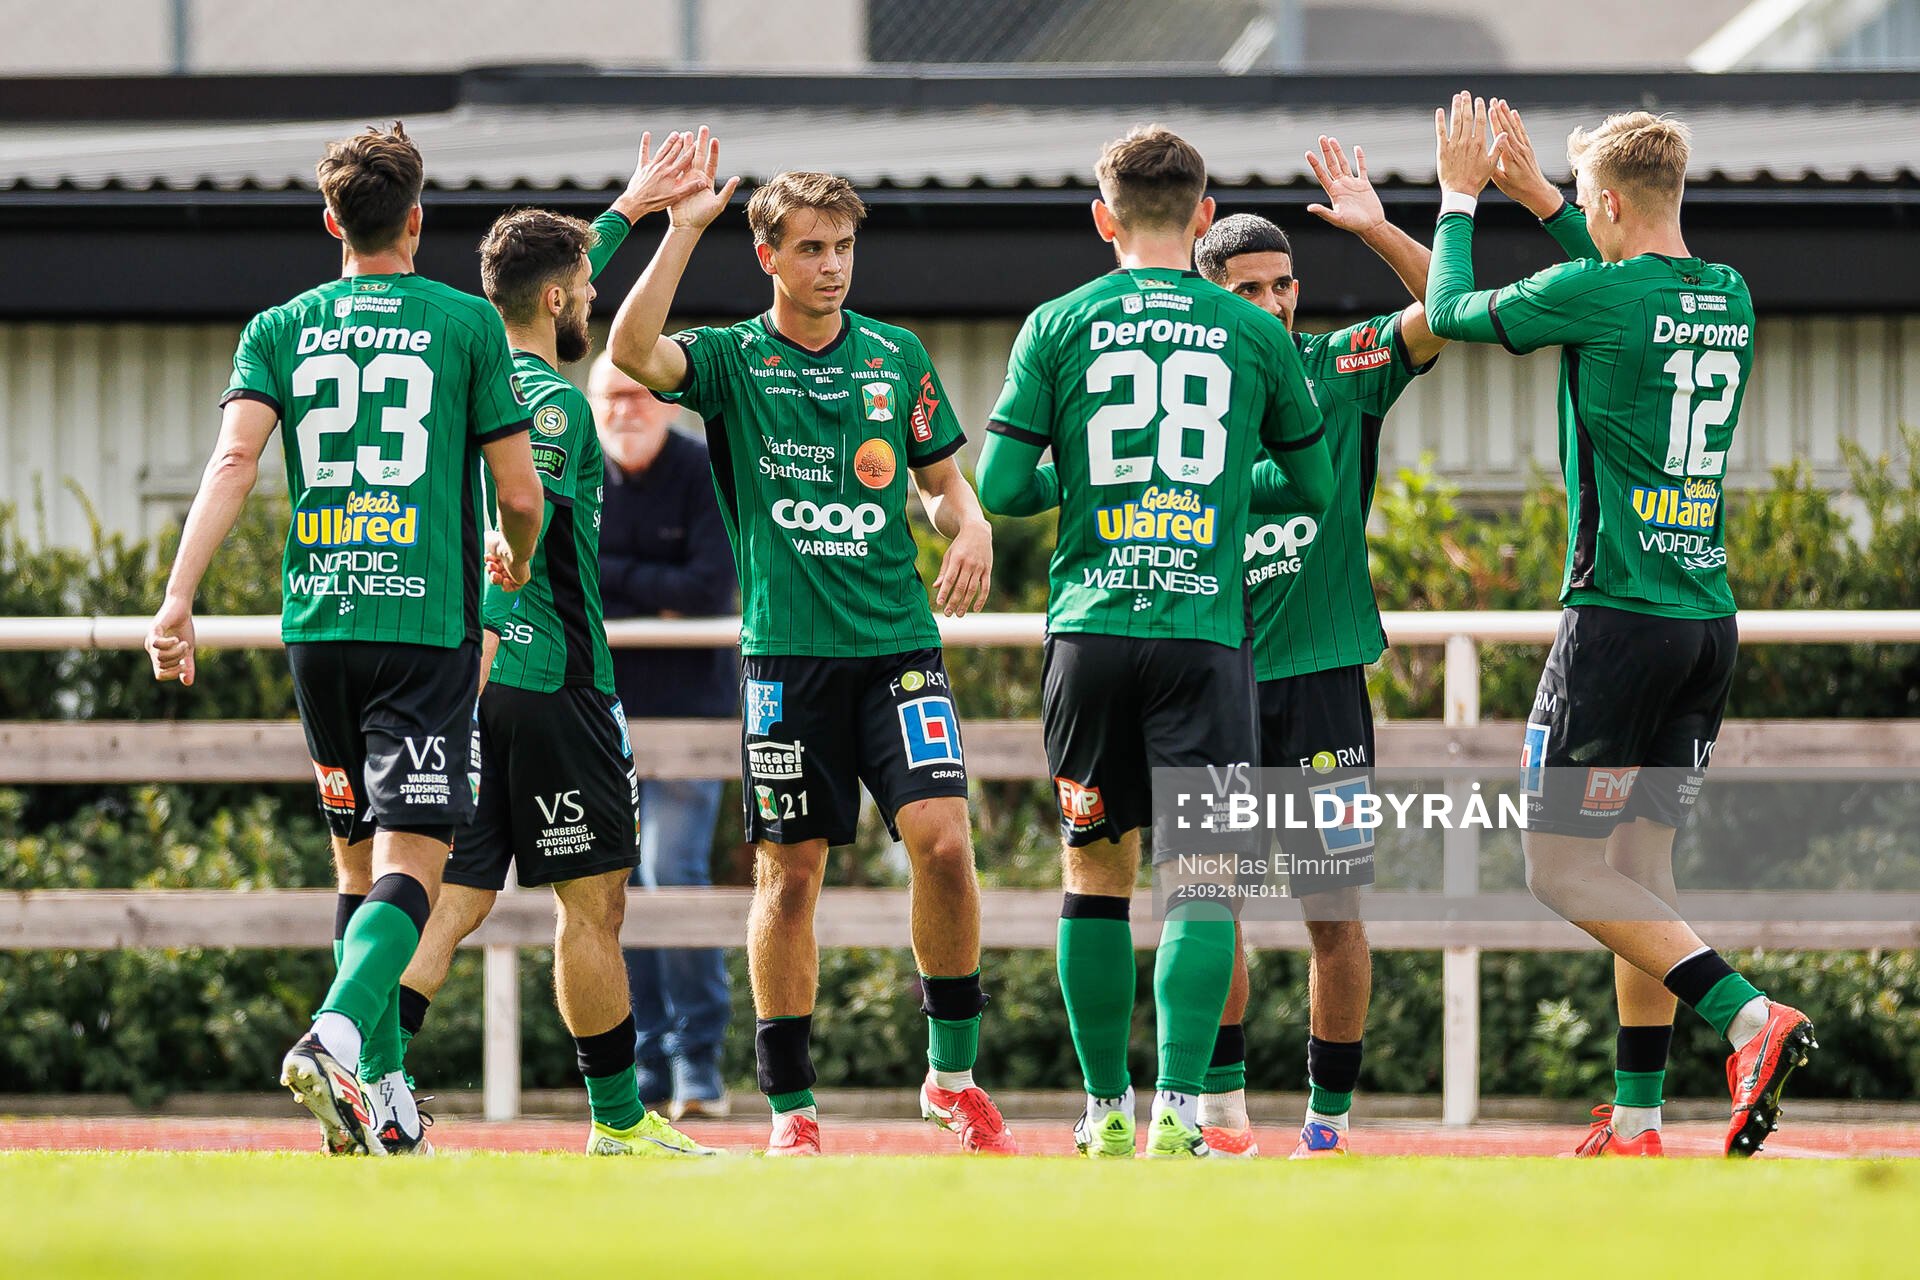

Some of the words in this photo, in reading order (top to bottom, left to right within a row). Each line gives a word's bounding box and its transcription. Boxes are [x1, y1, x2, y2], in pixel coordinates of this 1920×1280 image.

[354, 304, 398, 313] KOMMUN
[355, 296, 402, 306] VARBERGS
[296, 325, 431, 355] Derome
[1090, 319, 1228, 350] Derome
[1653, 314, 1749, 347] Derome
[776, 369, 798, 378] ENERG
[802, 367, 844, 376] DELUXE
[815, 376, 833, 384] BIL
[765, 387, 797, 396] CRAFT
[292, 353, 434, 488] 23
[1086, 350, 1232, 486] 28
[1663, 349, 1741, 476] 12
[532, 449, 565, 467] NIBET
[762, 435, 835, 463] Varbergs
[759, 457, 834, 483] Sparbank
[347, 491, 400, 514] Gekås
[1142, 486, 1201, 513] Gekås
[296, 508, 417, 544] Ullared
[1097, 503, 1215, 545] Ulared
[792, 538, 868, 557] VARBERG
[1108, 545, 1198, 570] NORDIC
[309, 551, 398, 573] NORDIC
[1245, 557, 1301, 586] RBERG
[288, 575, 426, 598] WELLNESS
[1083, 567, 1219, 595] WELLNESS
[404, 736, 446, 772] VS
[407, 774, 448, 784] VARBERGS
[932, 770, 960, 780] CRAFT
[534, 789, 585, 825] VS
[781, 791, 809, 820] 21
[536, 832, 597, 849] STADSHOTELL
[542, 823, 588, 838] VARBERGS
[544, 847, 552, 857] &
[553, 845, 574, 857] ASIA
[574, 842, 592, 855] SPA
